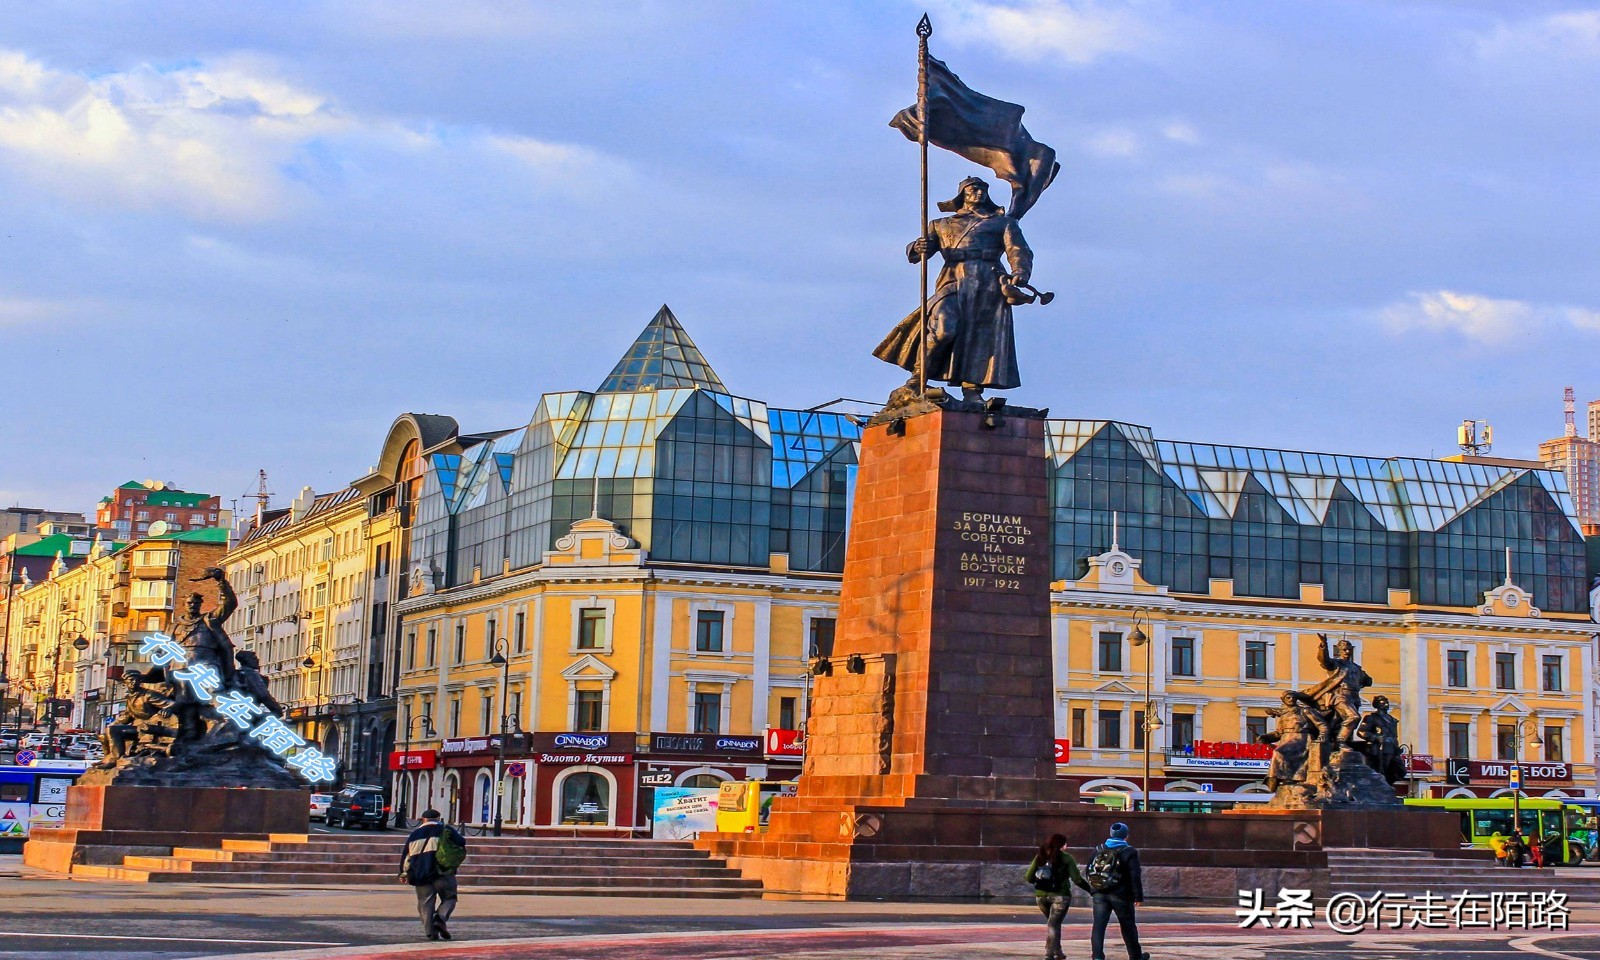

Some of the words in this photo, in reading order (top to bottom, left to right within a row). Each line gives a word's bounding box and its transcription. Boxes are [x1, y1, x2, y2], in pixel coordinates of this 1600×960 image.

[963, 512, 1021, 524] БОРЦАМ
[953, 521, 971, 531] ЗА
[979, 523, 1031, 535] ВЛАСТЬ
[961, 532, 1024, 545] СОВЕТОВ
[984, 543, 1001, 553] НА
[961, 552, 1025, 565] ДАЛЬНЕМ
[961, 562, 1024, 575] ВОСТОКЕ
[554, 735, 608, 747] CINNABON
[716, 739, 759, 749] CINNABON
[540, 753, 581, 763] Золото
[584, 753, 625, 764] Якутии
[1481, 764, 1509, 777] ИЛЬ
[1531, 763, 1568, 778] БОТЭ
[642, 773, 672, 784] TELE2
[50, 787, 61, 795] 62
[677, 796, 708, 805] Хватит
